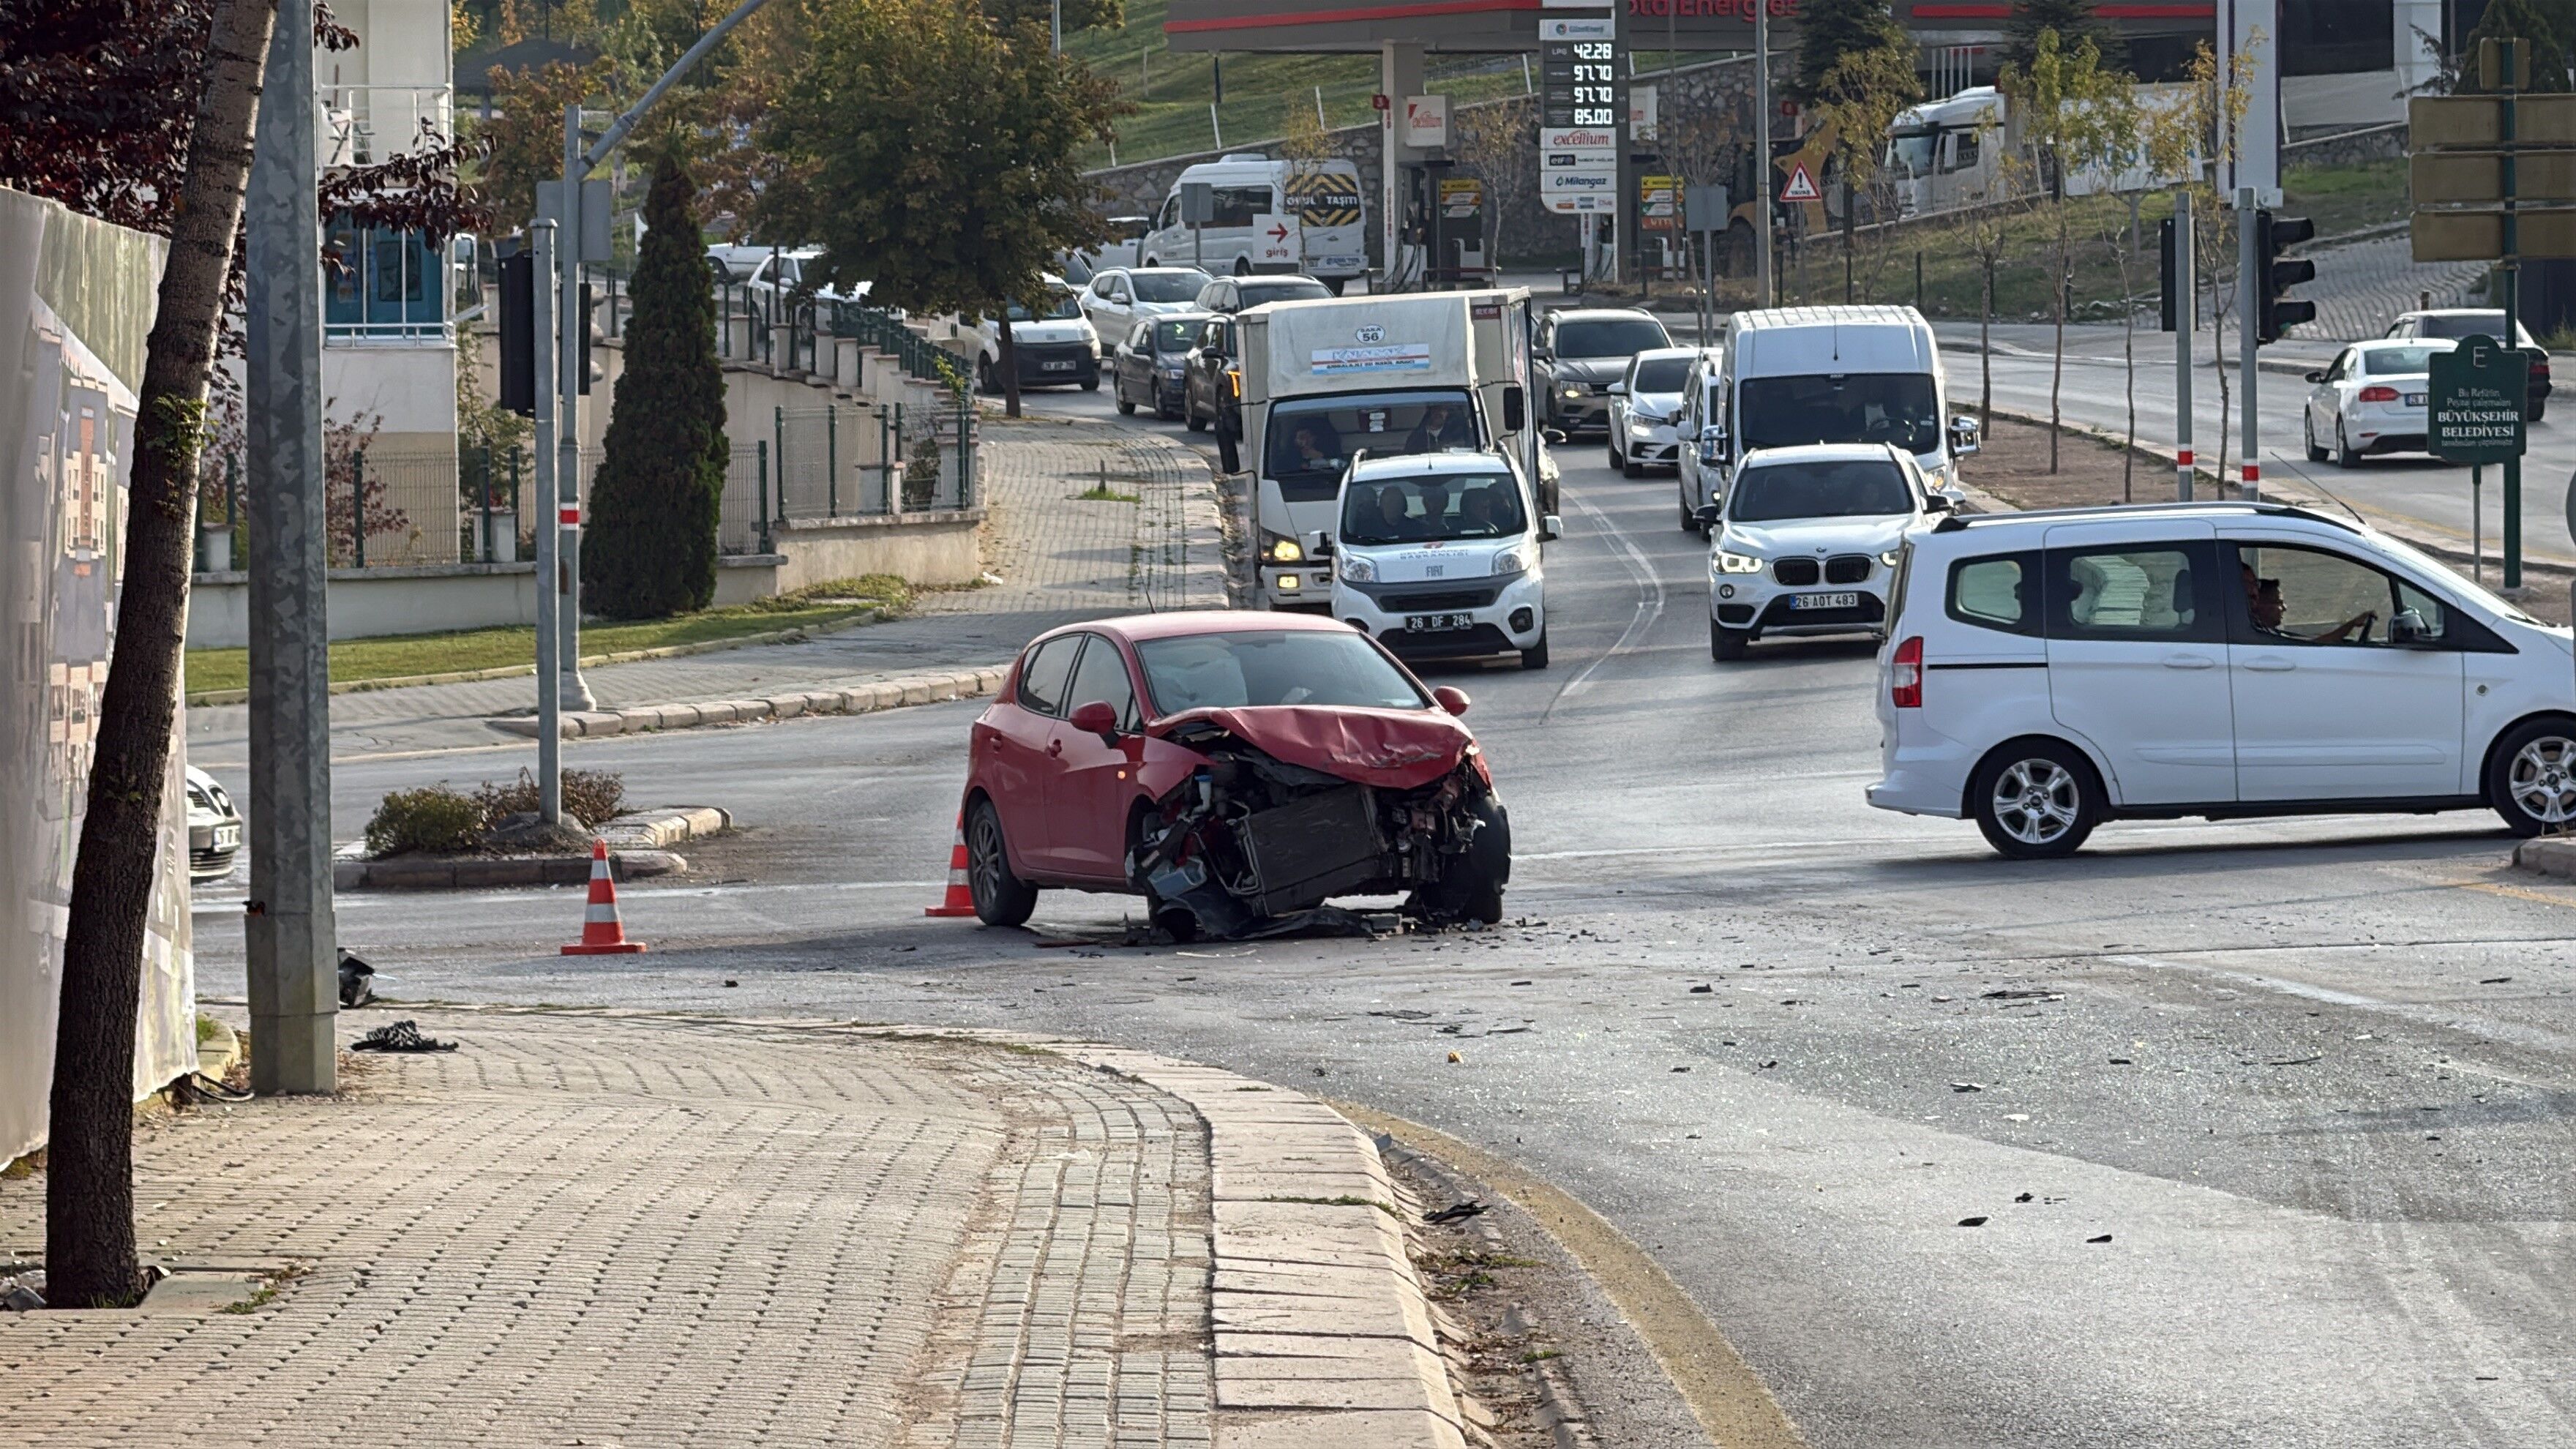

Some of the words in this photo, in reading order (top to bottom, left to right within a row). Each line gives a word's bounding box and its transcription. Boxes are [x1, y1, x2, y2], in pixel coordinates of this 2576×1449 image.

[1574, 43, 1611, 59] 42.28
[1574, 65, 1612, 80] 97.70
[1574, 87, 1612, 102] 97.70
[1574, 109, 1612, 124] 85.00
[1553, 130, 1609, 146] excellium
[1565, 176, 1607, 188] Milangaz
[1325, 196, 1358, 207] TAŞITI
[1265, 247, 1288, 258] giriş
[2473, 346, 2489, 367] E
[2438, 408, 2519, 424] BÜYÜKŞEHİR
[2441, 424, 2515, 437] BELEDİYESİ
[1426, 565, 1444, 577] FIAT
[1797, 596, 1808, 607] 26
[1813, 596, 1832, 607] AOT
[1835, 594, 1855, 605] 483
[1411, 617, 1423, 629] 26
[1431, 615, 1444, 627] DF
[1453, 614, 1470, 626] 284
